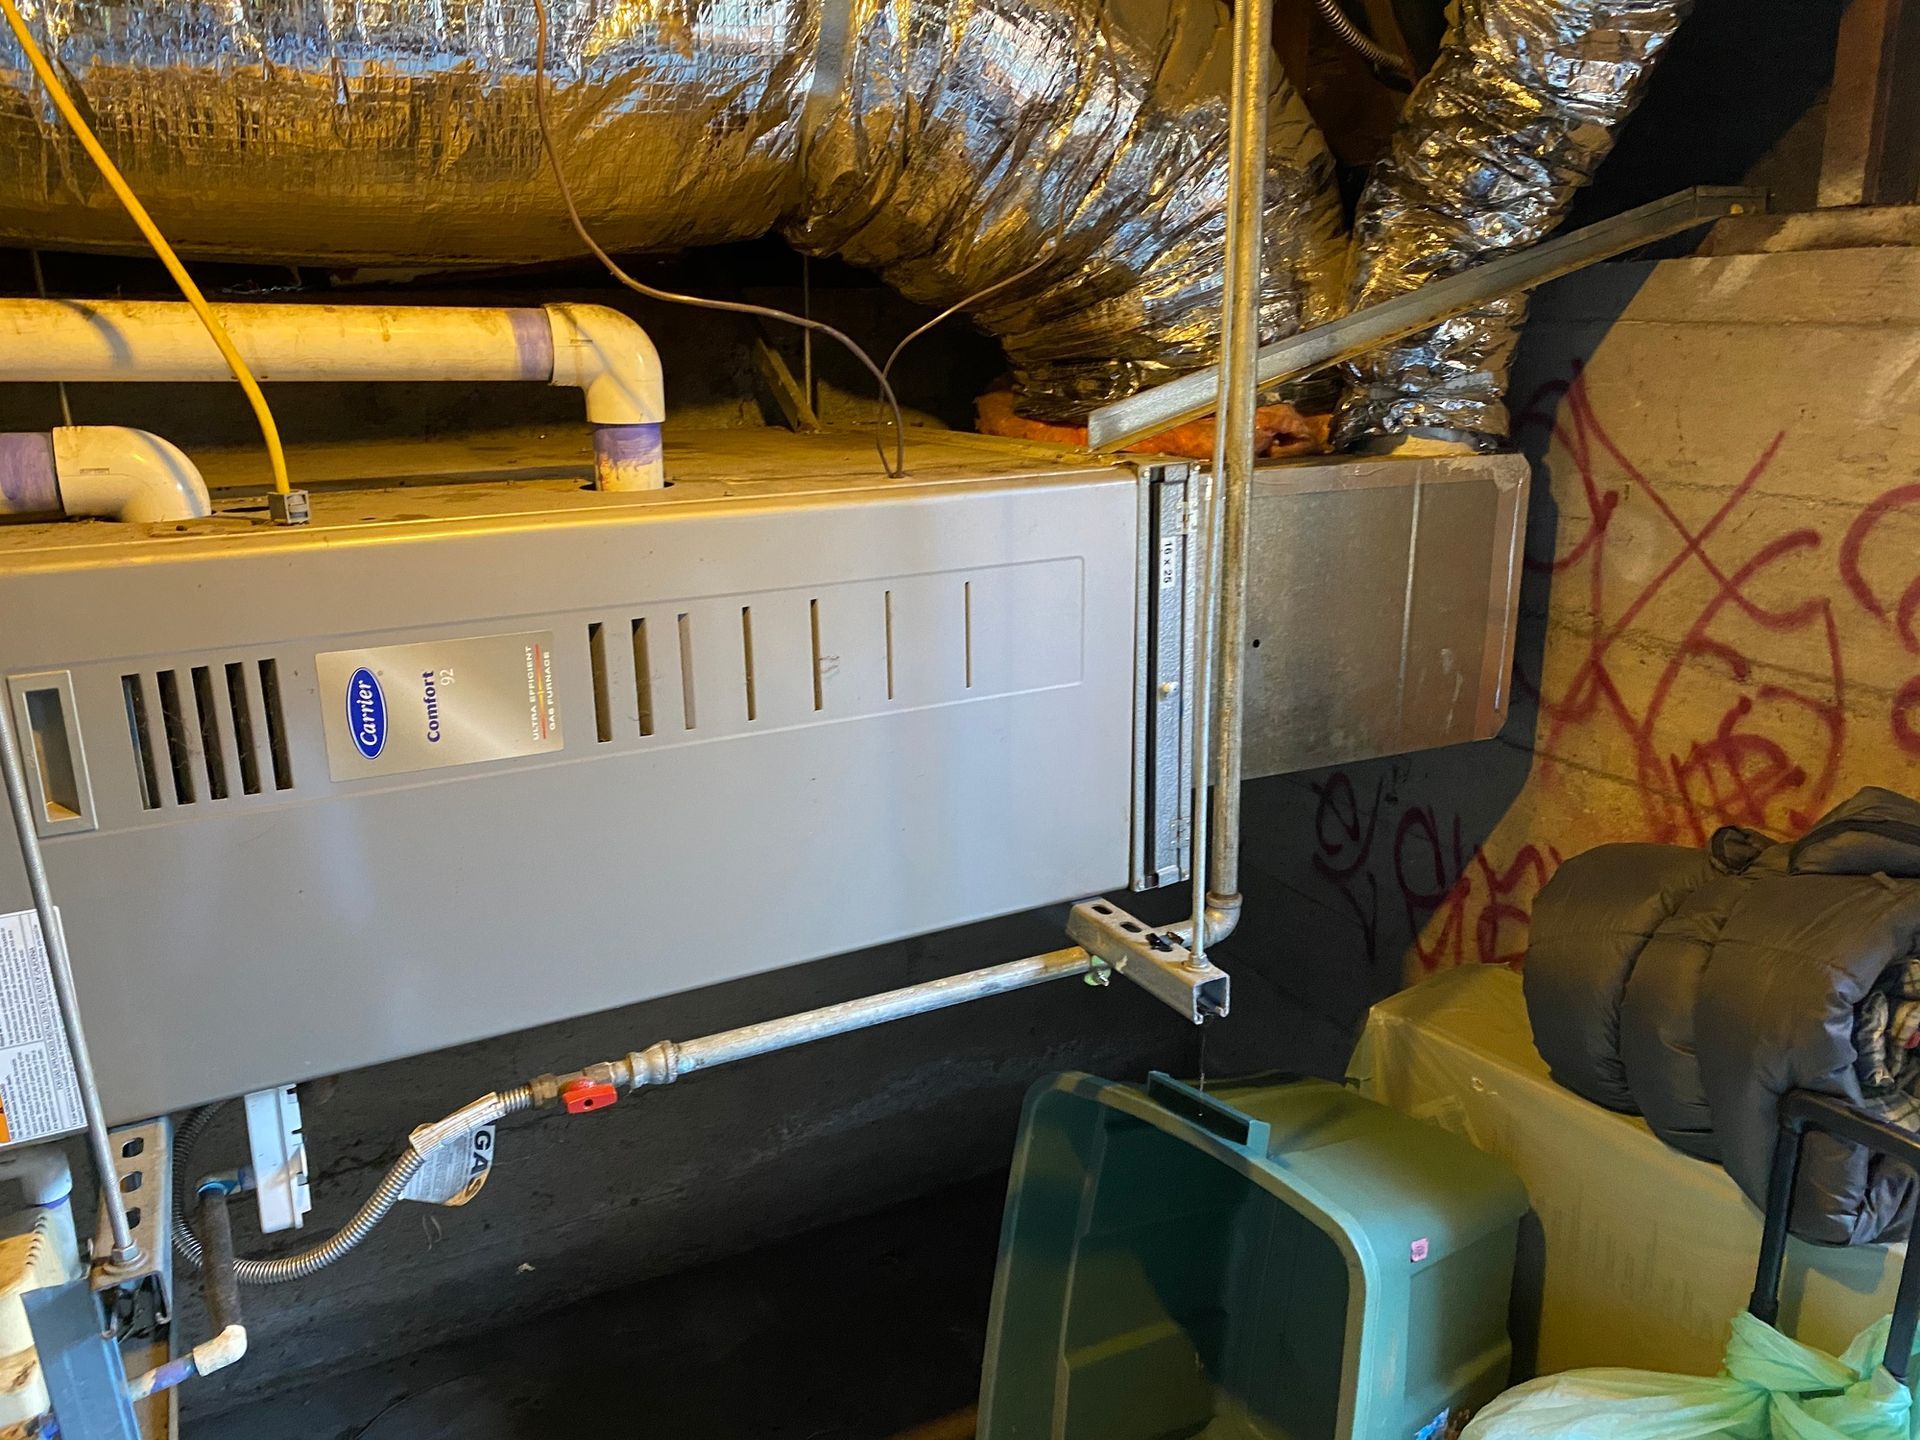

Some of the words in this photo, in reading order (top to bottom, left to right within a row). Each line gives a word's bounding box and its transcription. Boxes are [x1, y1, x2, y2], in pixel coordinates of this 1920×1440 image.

[440, 667, 455, 686] 92
[525, 645, 536, 703] EFFICIENT
[543, 651, 554, 705] FURNACE
[355, 679, 378, 746] Carrier
[421, 670, 441, 743] Comfort
[530, 704, 540, 741] ULTRA
[548, 707, 557, 731] GAS
